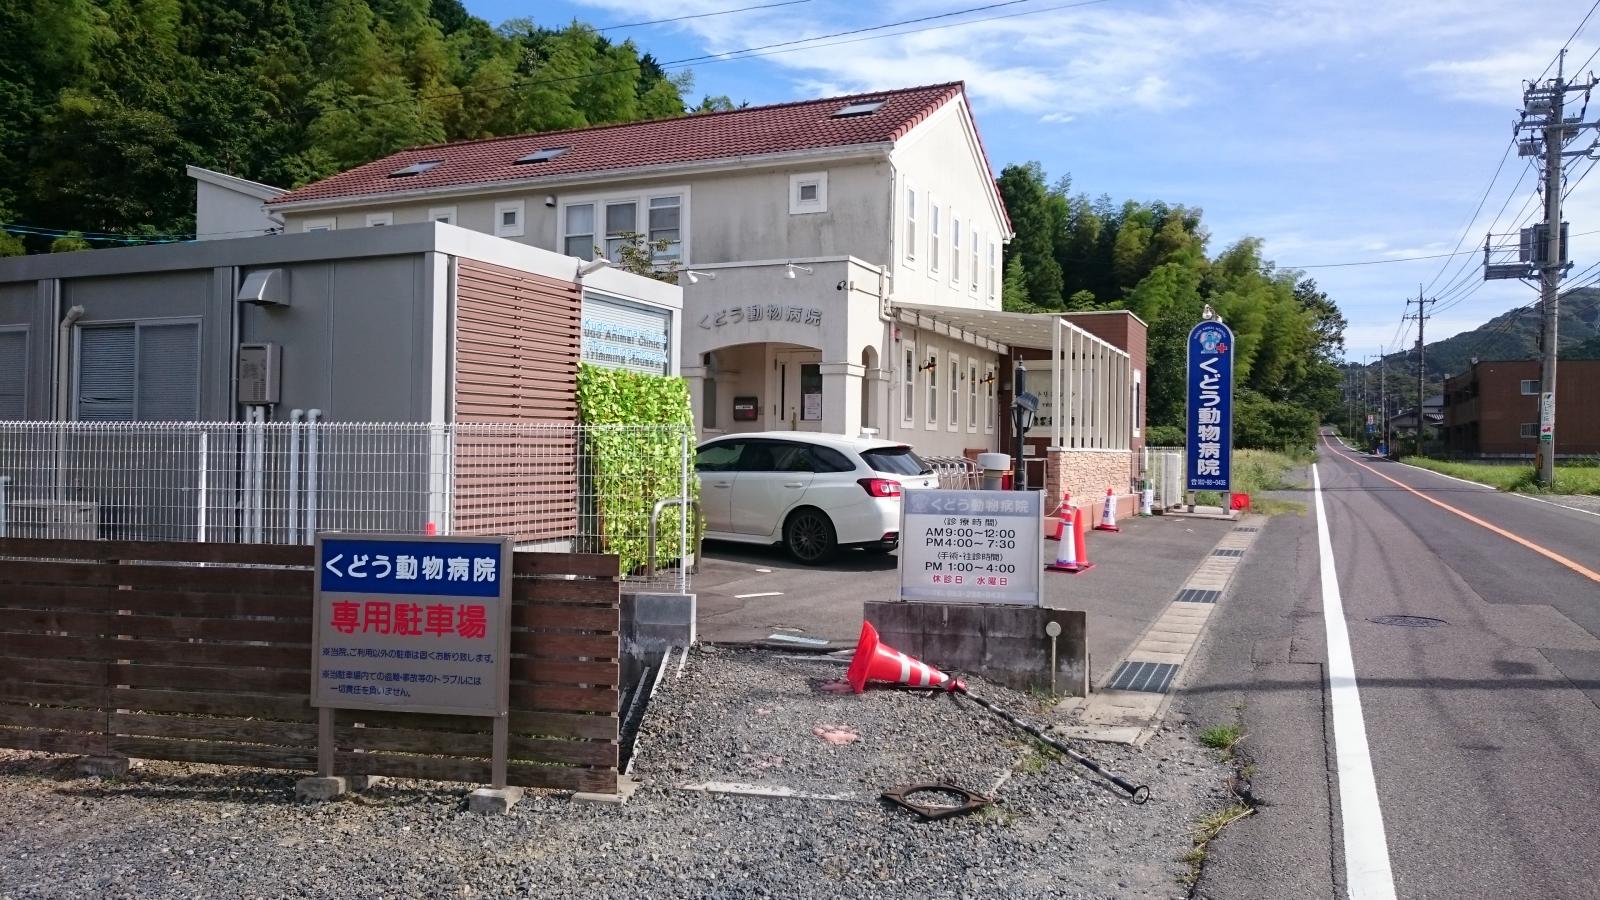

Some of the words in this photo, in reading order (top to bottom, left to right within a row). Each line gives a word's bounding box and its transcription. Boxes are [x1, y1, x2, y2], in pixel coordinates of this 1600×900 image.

[698, 304, 822, 330] くどう動物病院
[1197, 357, 1221, 476] くどう動物病院
[930, 499, 1030, 513] くどう動物病院
[325, 553, 496, 582] くどう動物病院
[976, 576, 1008, 586] 水曜日
[330, 600, 487, 639] 専用駐車場
